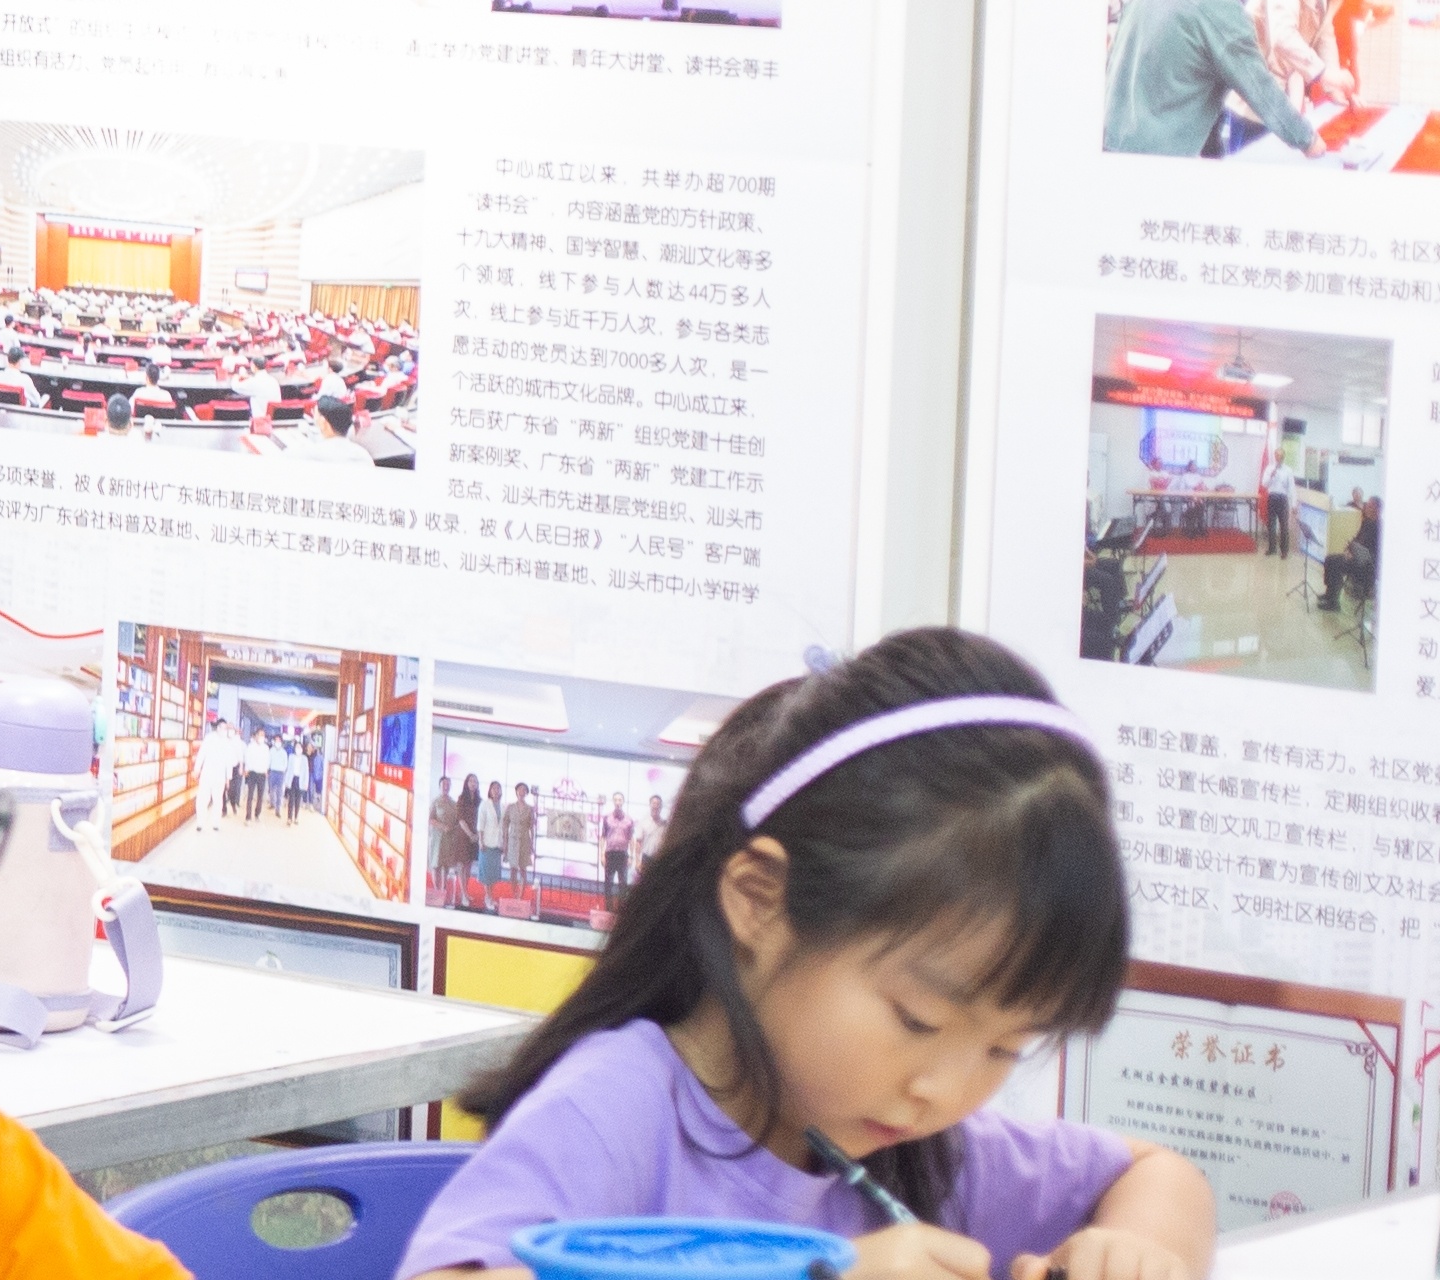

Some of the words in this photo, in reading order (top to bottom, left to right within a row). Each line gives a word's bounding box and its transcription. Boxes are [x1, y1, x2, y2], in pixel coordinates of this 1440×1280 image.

[497, 158, 776, 198] 中心成立以来，共举办超700期
[456, 229, 772, 272] 十九大精神、国学智慧、潮汕文化等多
[455, 262, 771, 309] 个领域，线下参与人数达44万多人
[453, 300, 770, 346] 次，线上参与近千万人次，参与各类志
[453, 335, 768, 381] 愿活动的党员达到7000多人次，是一
[450, 407, 765, 458] 先后获广东省“两新”组织党建十佳创
[449, 443, 764, 493] 新案例奖、广东省“两新”党建工作示
[448, 478, 763, 531] 范点、汕头市先进基层党组织、汕头市
[1115, 800, 1440, 864] 围。设置创文巩卫宣传栏，与辖区
[1171, 1030, 1288, 1073] 荣誉证书
